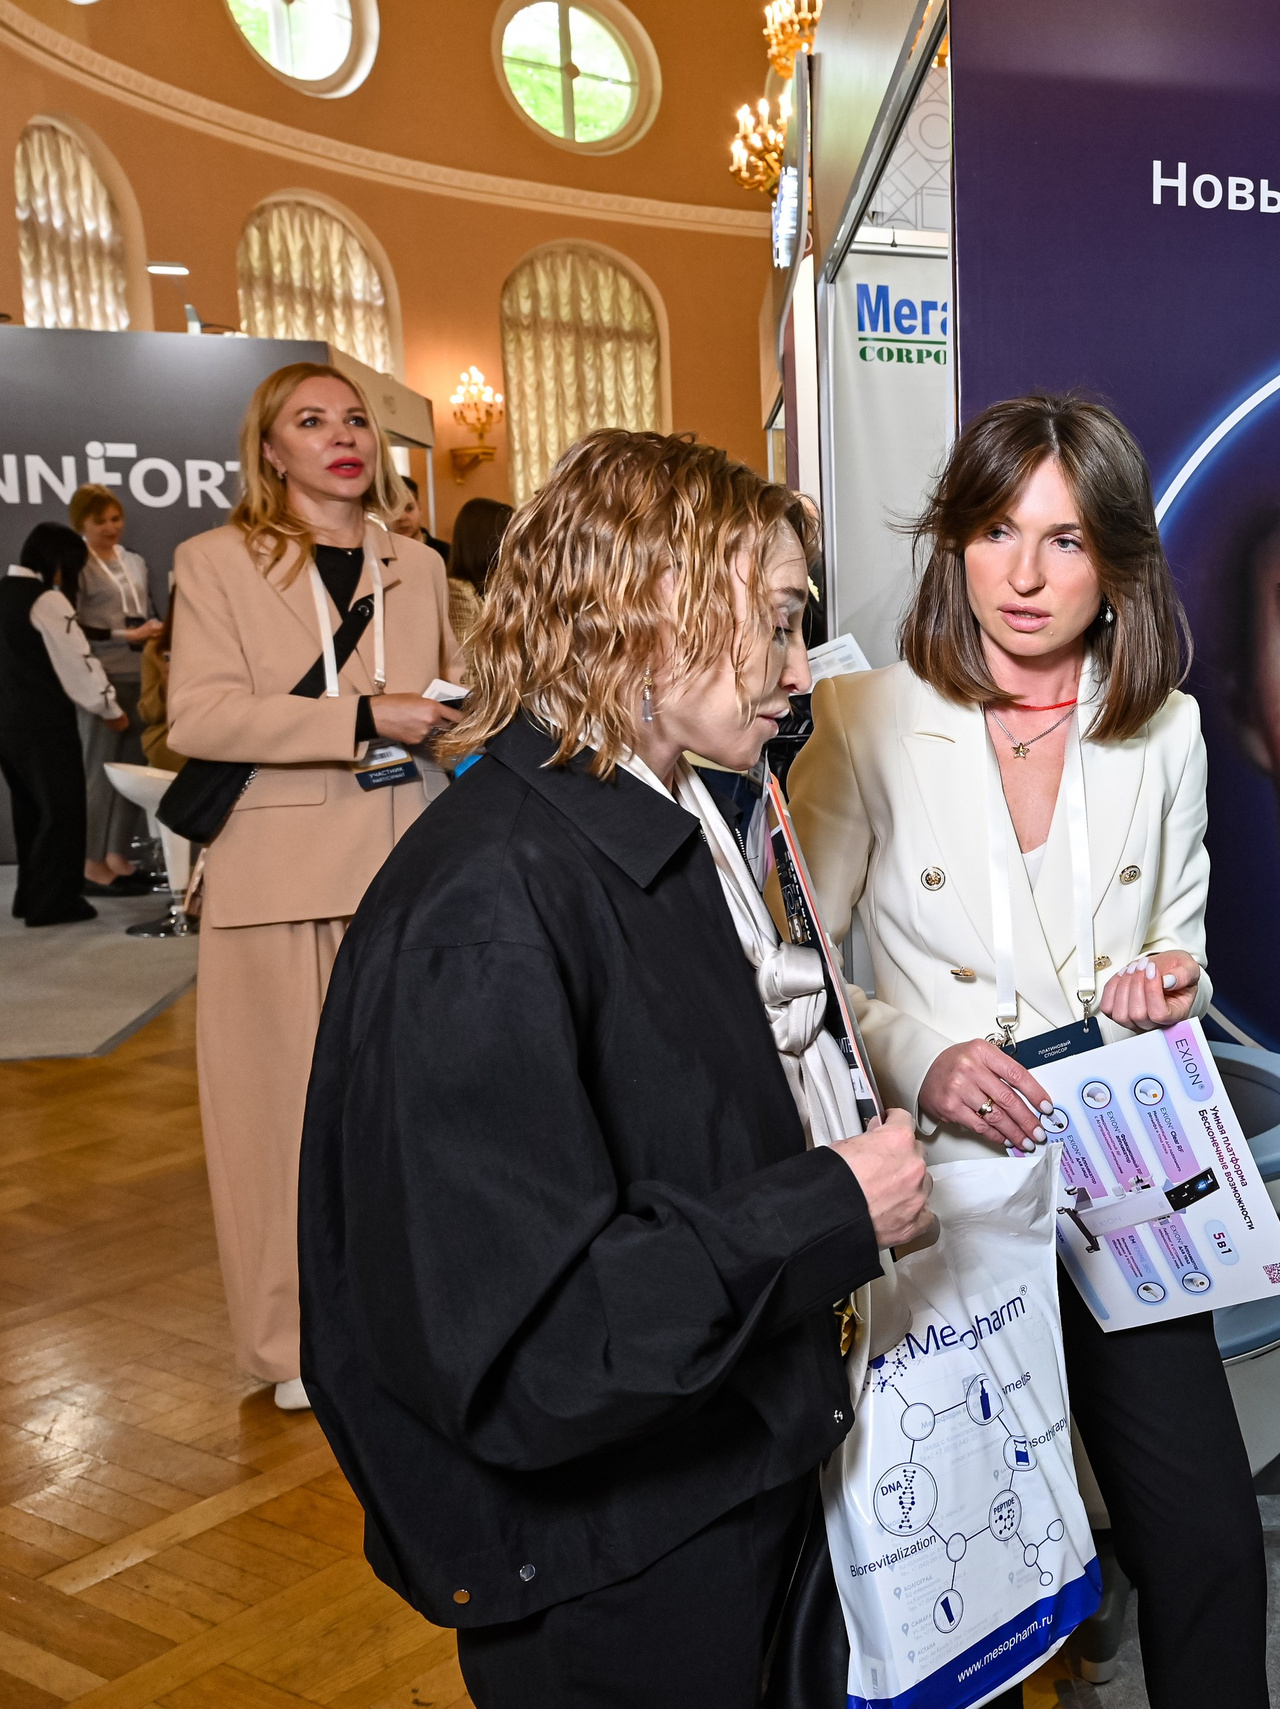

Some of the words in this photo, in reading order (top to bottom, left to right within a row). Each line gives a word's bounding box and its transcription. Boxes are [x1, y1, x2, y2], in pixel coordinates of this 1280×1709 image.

[368, 766, 404, 779] УЧАСТНИК
[372, 772, 405, 784] PARTICIPANT
[1038, 1039, 1072, 1056] ПЛАТИНОВЫЙ
[1043, 1047, 1068, 1059] СПОНСОР
[1175, 1037, 1206, 1091] EXION®
[1210, 1105, 1228, 1135] Умная
[1224, 1135, 1248, 1187] платформа
[1198, 1109, 1229, 1170] Бесконечные
[1223, 1171, 1255, 1231] возможности
[1213, 1232, 1226, 1240] 5
[1216, 1239, 1227, 1249] в
[1221, 1247, 1233, 1255] 1
[880, 1480, 903, 1497] DNA
[993, 1496, 1015, 1516] PEPTIDE
[849, 1533, 938, 1578] Biorevitalization
[956, 1612, 1054, 1684] www.mesopharm.ru
